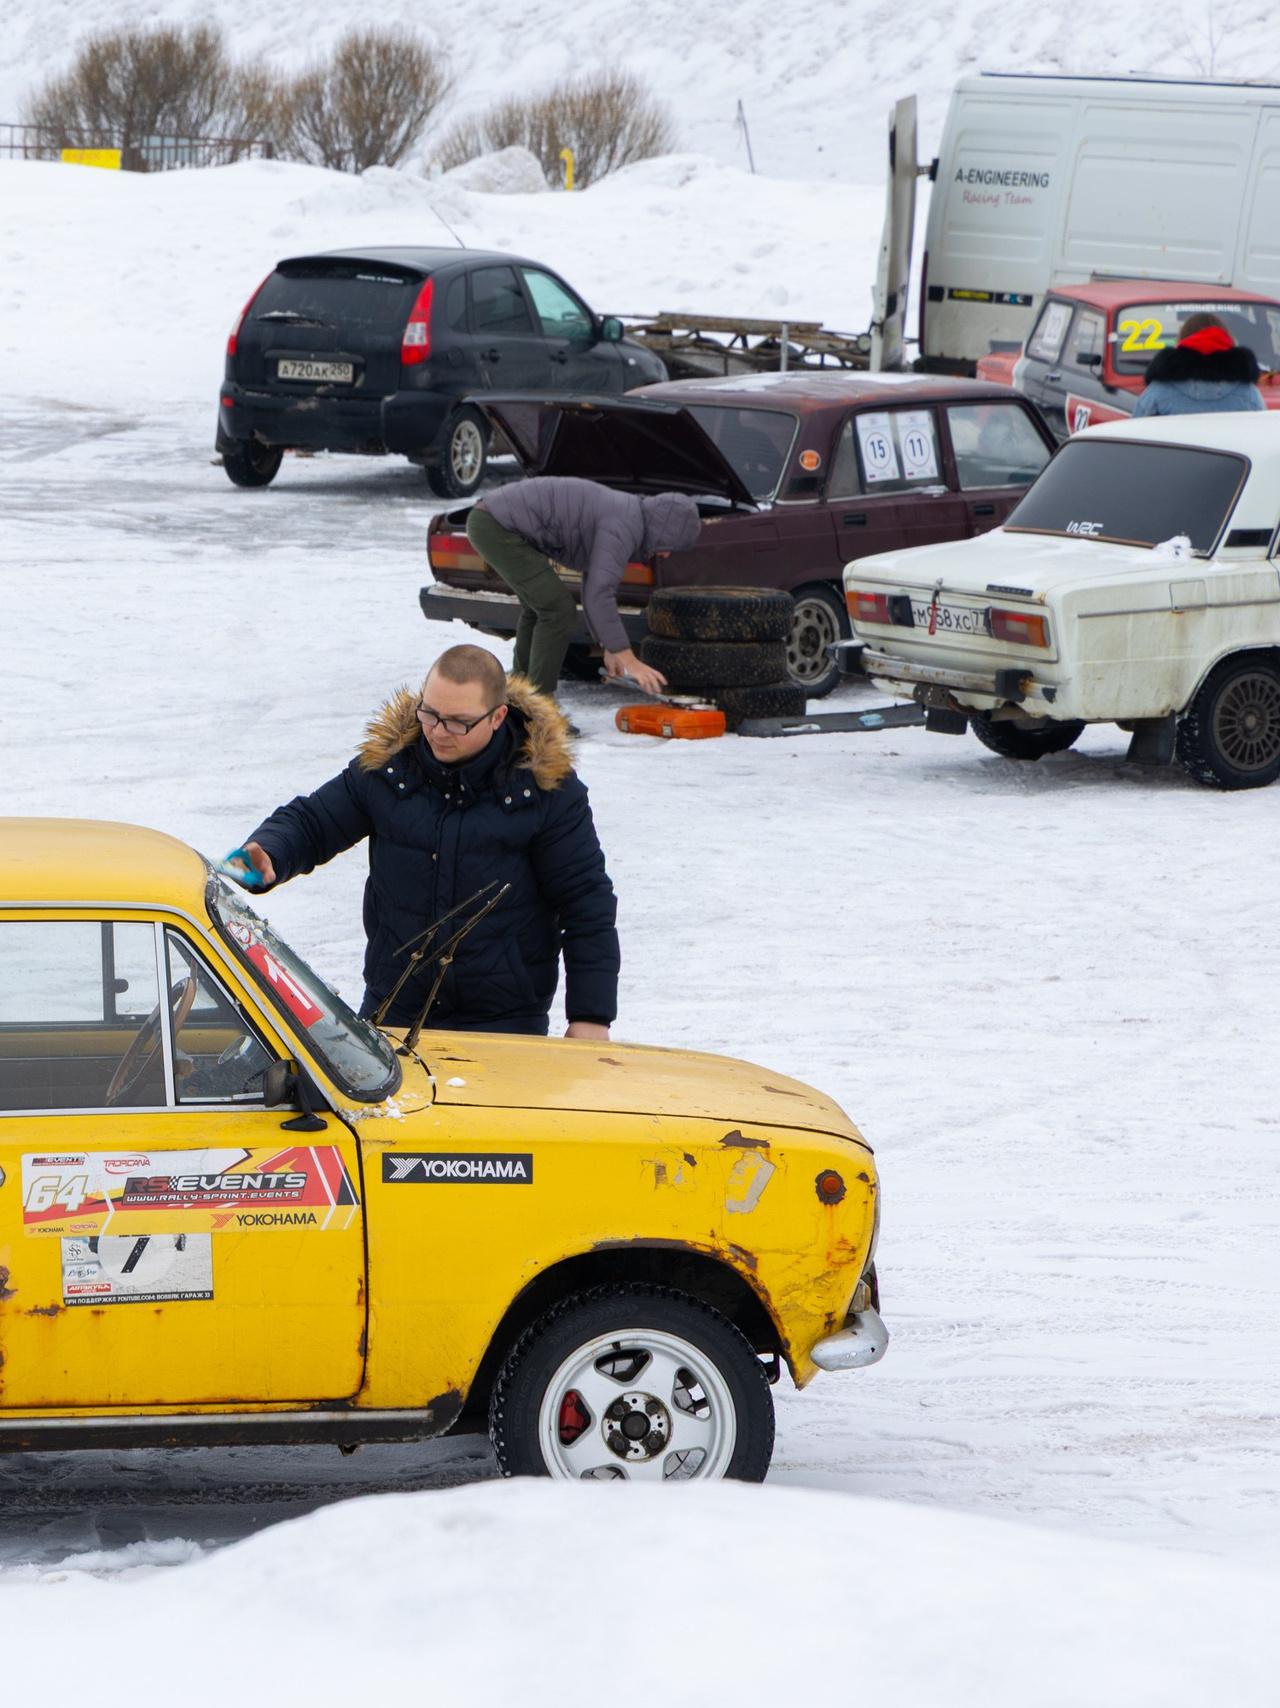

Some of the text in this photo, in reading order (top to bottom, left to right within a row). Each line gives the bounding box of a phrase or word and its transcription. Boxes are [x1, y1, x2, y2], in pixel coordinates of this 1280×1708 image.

[955, 168, 1050, 188] A-ENGINEERING
[962, 190, 1033, 208] Racing Team
[1120, 319, 1166, 351] 22
[870, 440, 886, 460] 15
[909, 438, 924, 457] 11
[104, 1159, 150, 1167] TROPICANA
[421, 1160, 527, 1178] YOKOHAMA
[127, 1173, 307, 1192] RS EVENTS
[25, 1175, 88, 1213] 64
[236, 1213, 317, 1226] YOKOHAMA
